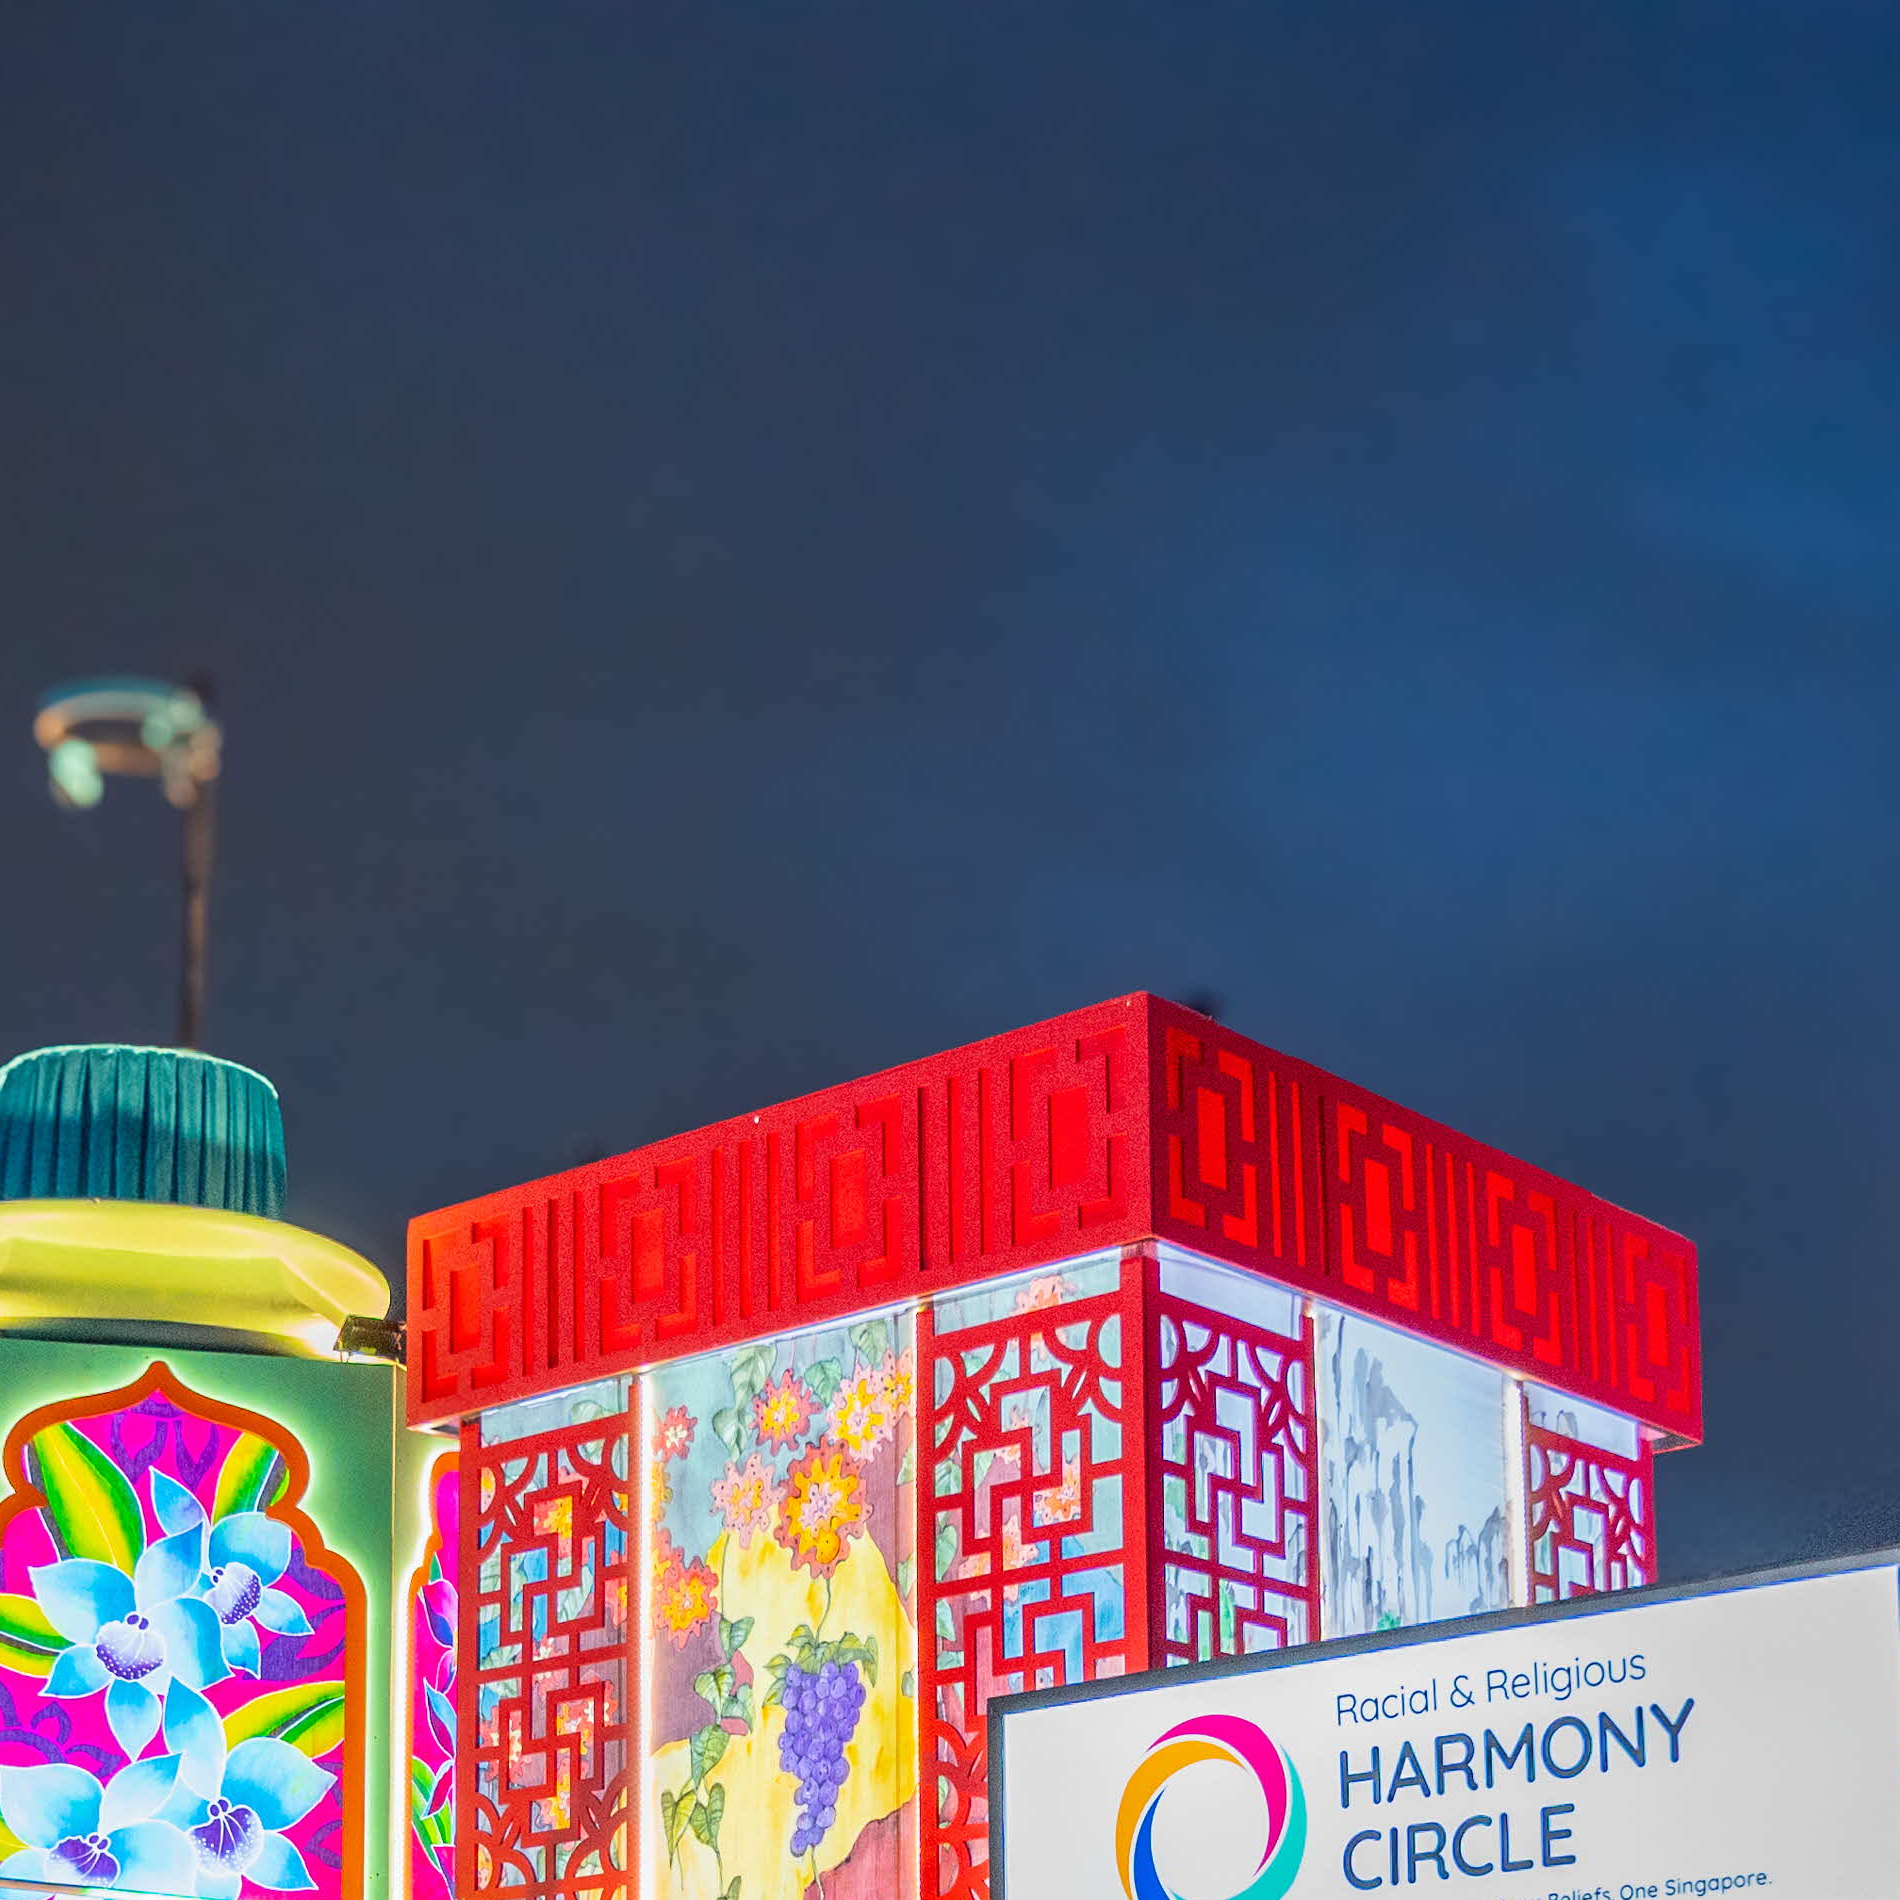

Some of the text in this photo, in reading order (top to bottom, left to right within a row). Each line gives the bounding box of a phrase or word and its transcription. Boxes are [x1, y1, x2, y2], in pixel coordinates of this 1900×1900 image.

[1335, 1654, 1648, 1728] Racial & Religious
[1339, 1697, 1697, 1811] HARMONY
[1342, 1802, 1578, 1892] CIRCLE
[1665, 1871, 1774, 1899] Singapore.
